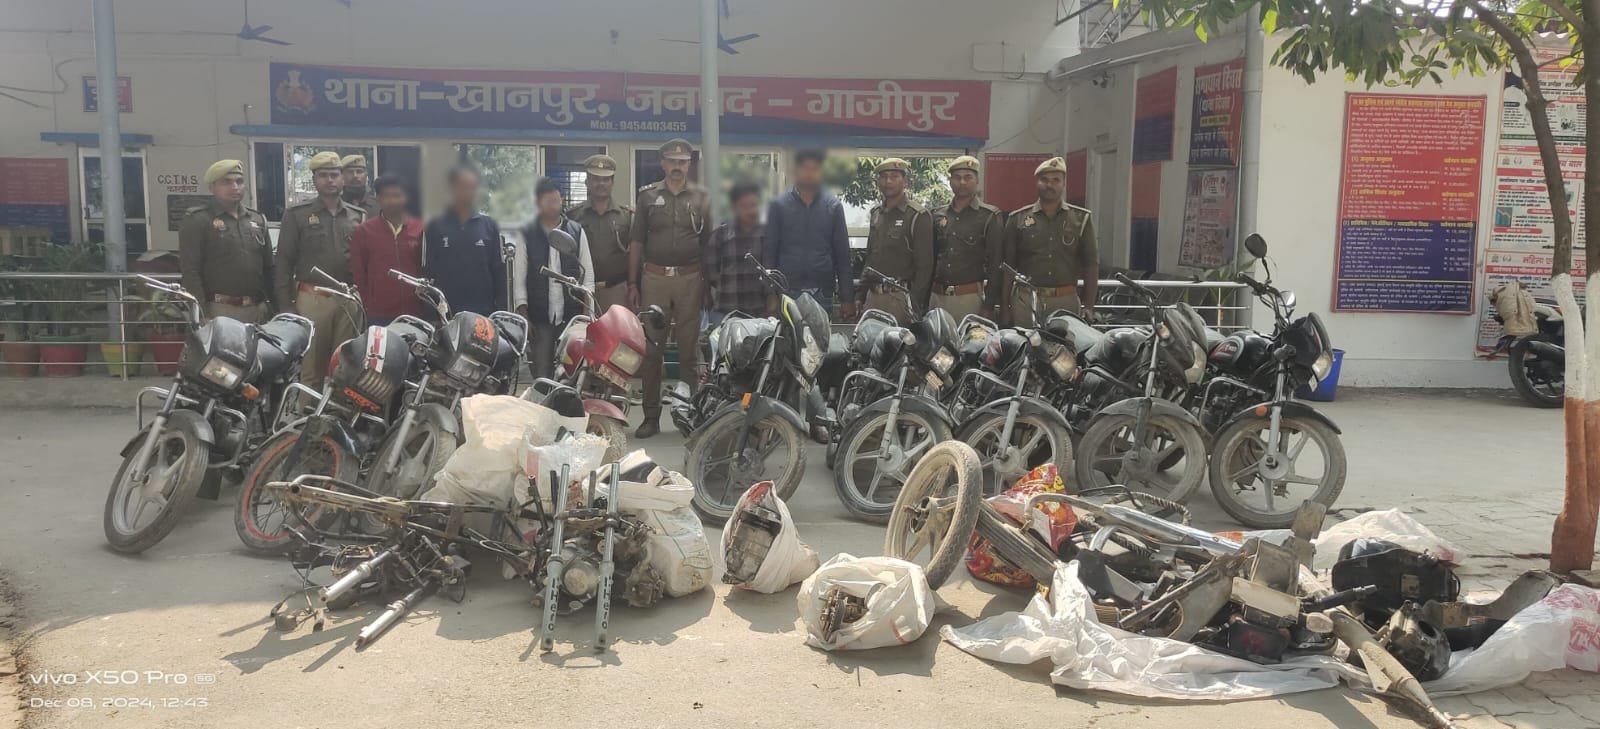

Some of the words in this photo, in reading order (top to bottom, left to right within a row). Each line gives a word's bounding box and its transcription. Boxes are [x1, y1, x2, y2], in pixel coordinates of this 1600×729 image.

[1223, 65, 1243, 90] दिवस
[805, 79, 960, 131] गाजीपुर
[620, 120, 687, 132] 9454403455
